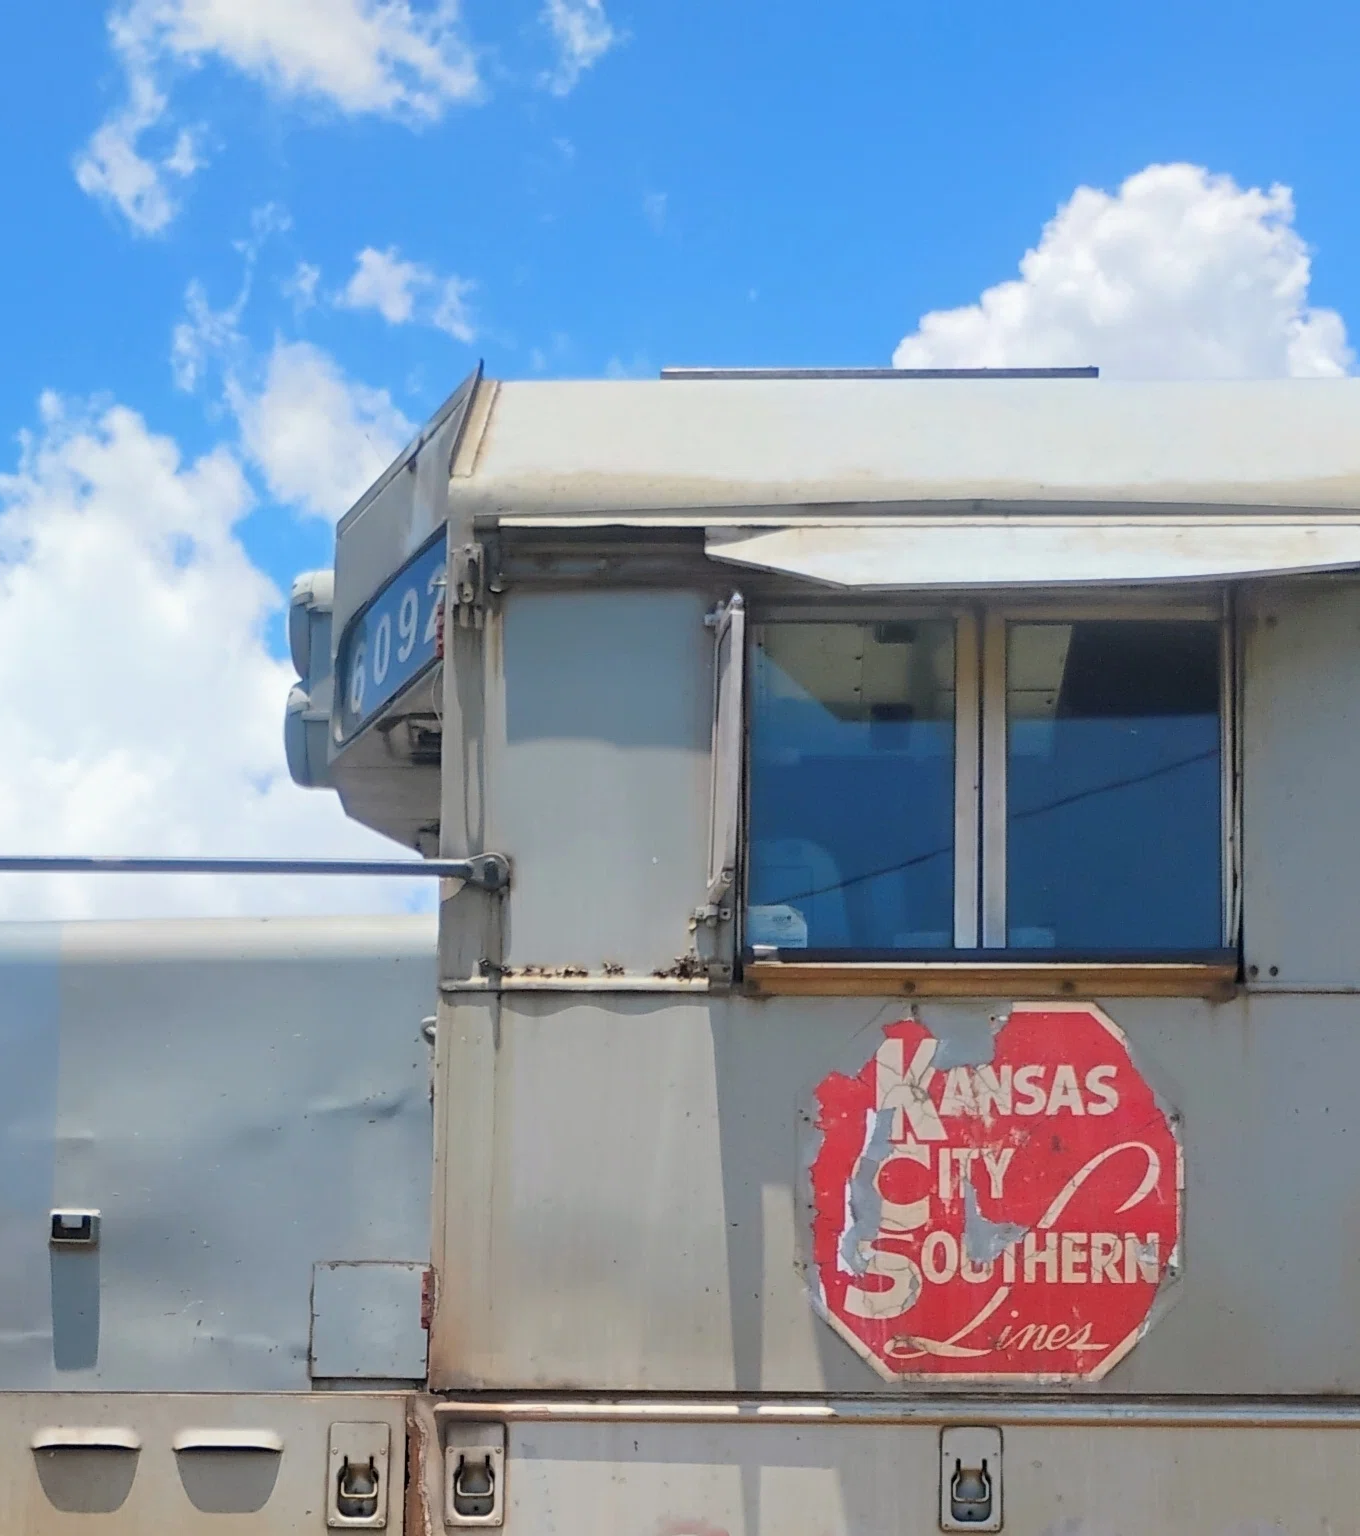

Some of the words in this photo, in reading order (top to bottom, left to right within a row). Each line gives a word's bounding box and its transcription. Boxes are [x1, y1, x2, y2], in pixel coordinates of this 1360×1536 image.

[876, 1038, 1121, 1141] KANSAS
[851, 1143, 1015, 1232] CITY
[884, 1286, 1111, 1359] Lines
